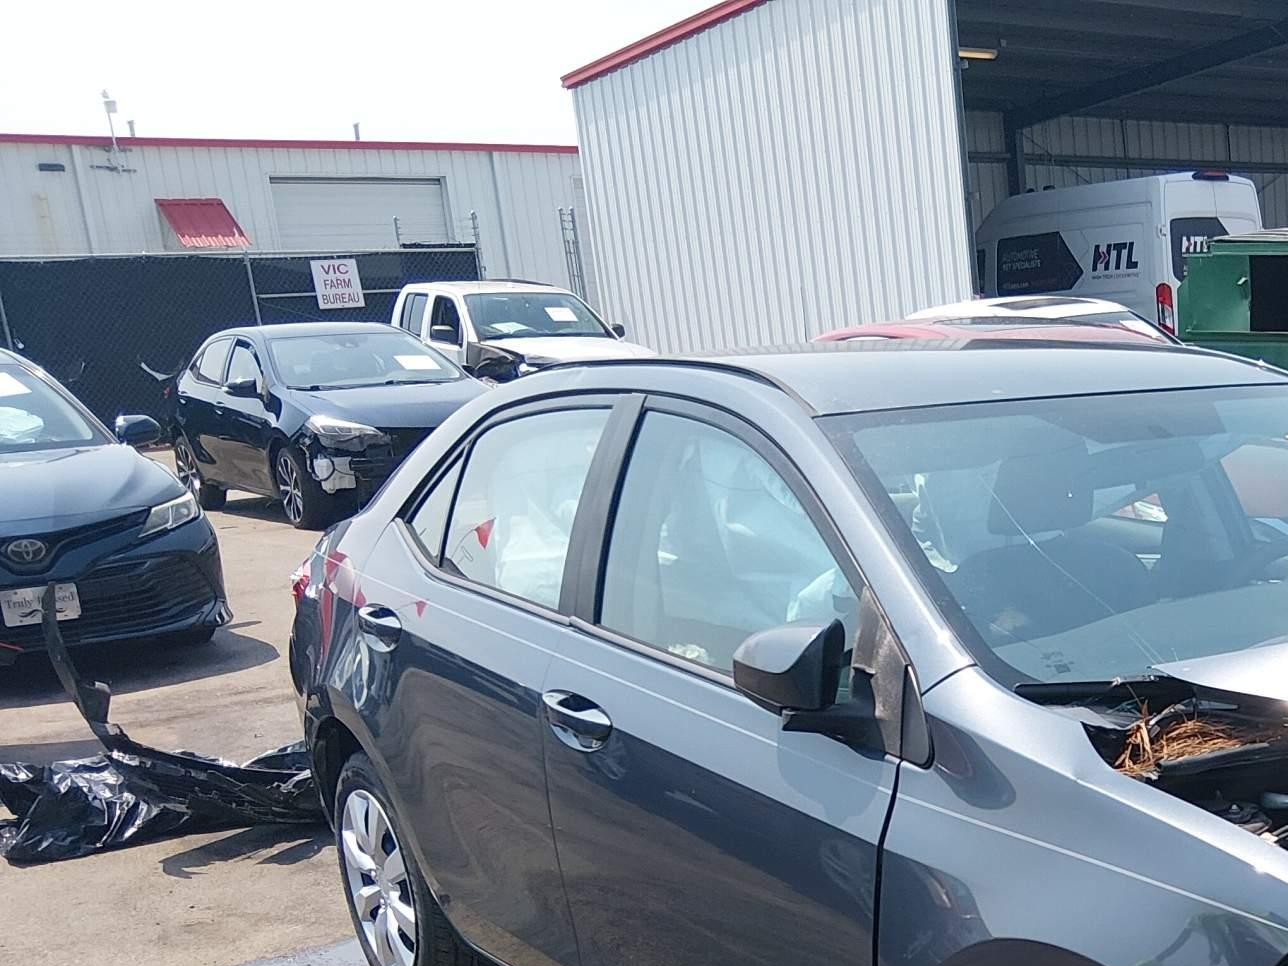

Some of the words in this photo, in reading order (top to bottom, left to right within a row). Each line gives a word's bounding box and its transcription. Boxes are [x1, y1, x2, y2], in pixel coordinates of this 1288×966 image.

[1092, 241, 1139, 272] HTL
[320, 263, 349, 275] VIC
[323, 278, 353, 290] FARM
[321, 291, 360, 305] BUREAU
[4, 597, 33, 609] Truly
